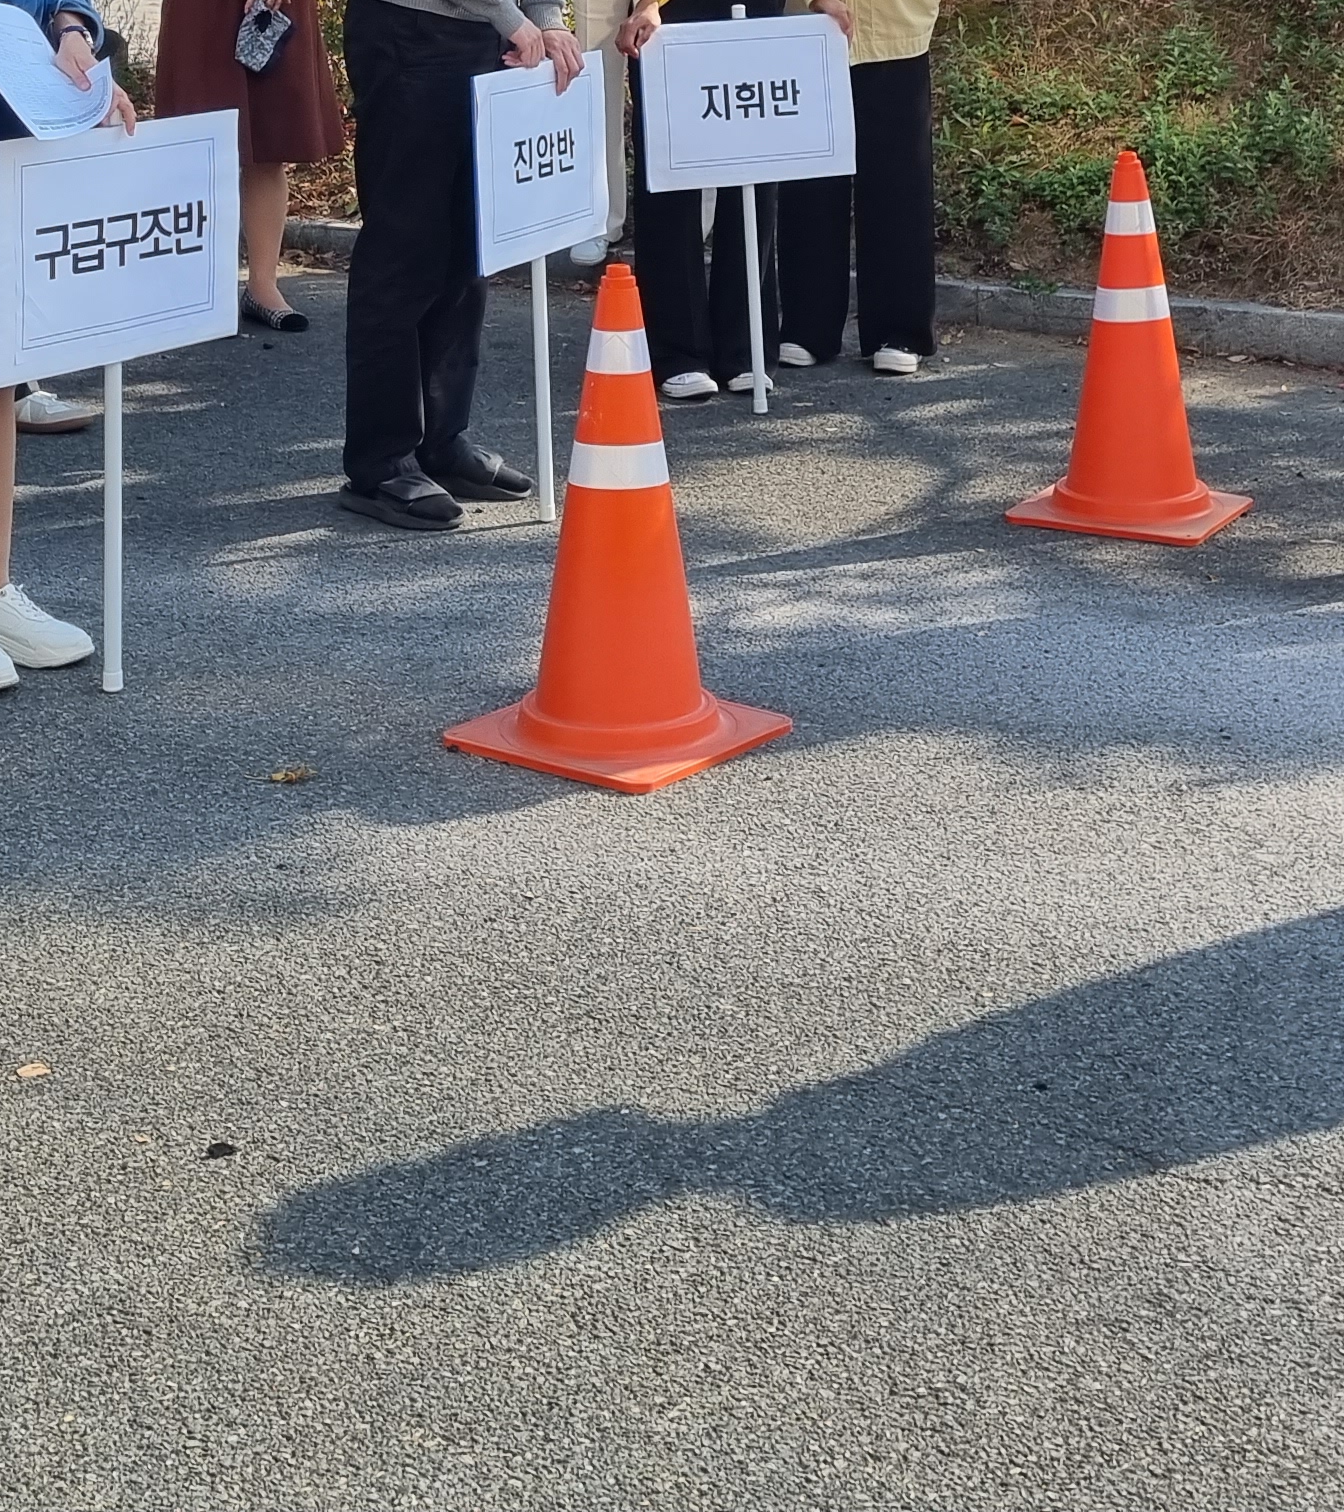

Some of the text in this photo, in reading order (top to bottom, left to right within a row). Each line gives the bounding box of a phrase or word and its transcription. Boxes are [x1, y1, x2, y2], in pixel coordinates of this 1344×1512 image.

[700, 78, 801, 122] 지휘반
[513, 127, 575, 185] 진압반
[34, 199, 208, 281] 구급구조반
